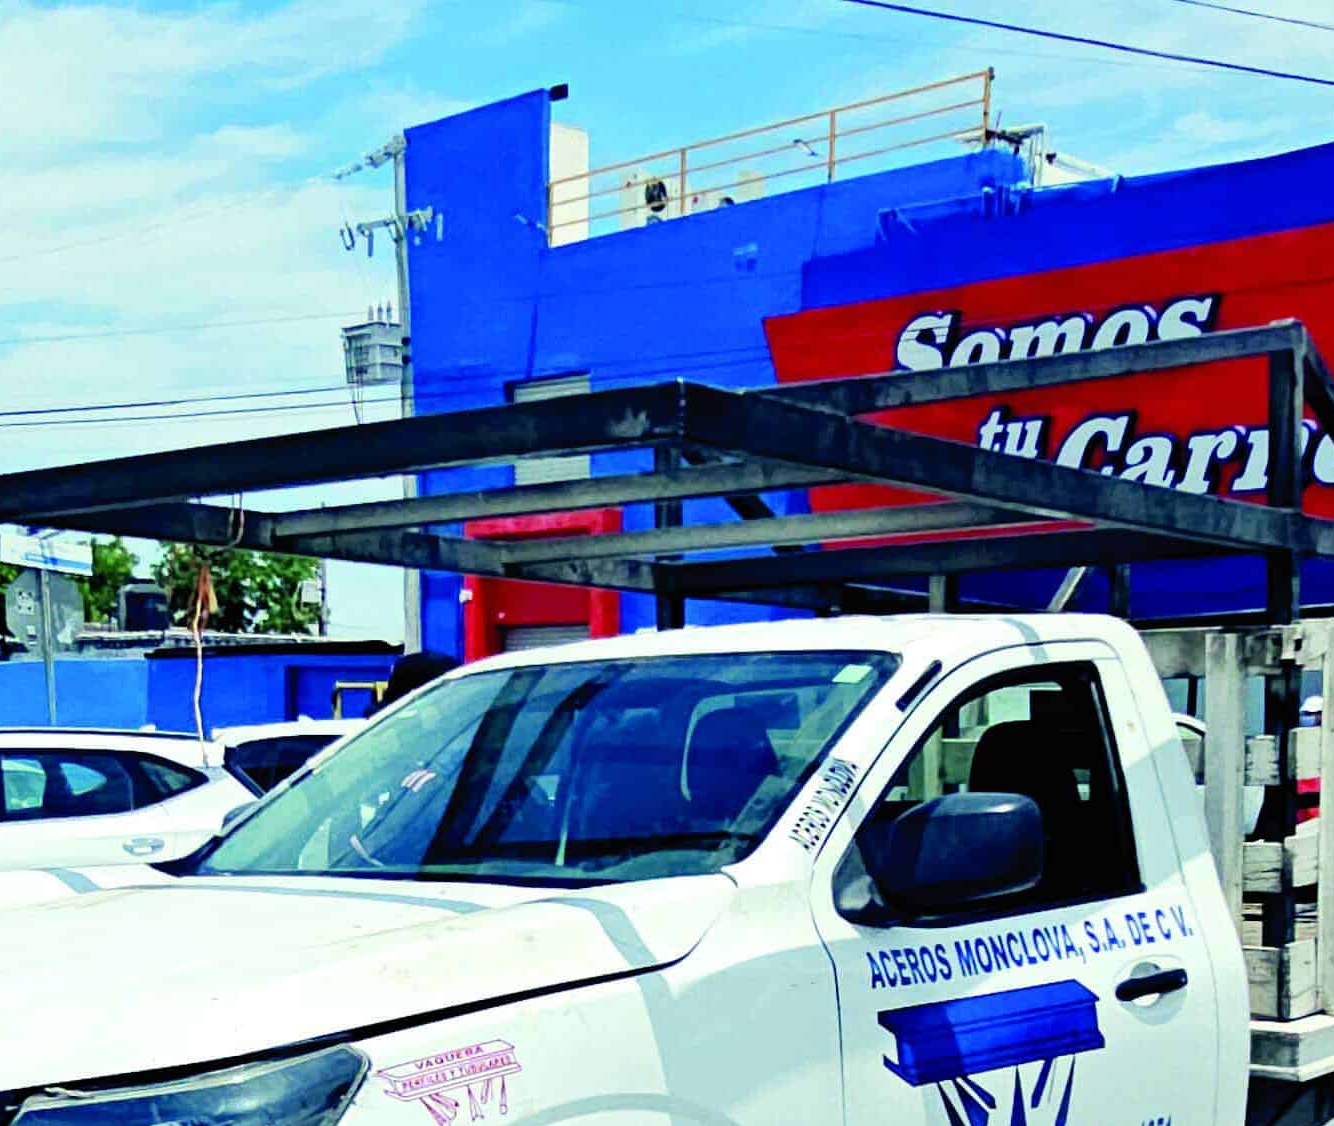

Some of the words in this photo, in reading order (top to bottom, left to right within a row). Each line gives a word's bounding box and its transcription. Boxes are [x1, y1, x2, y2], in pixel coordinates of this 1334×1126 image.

[896, 297, 1213, 372] Somos
[979, 410, 1044, 459] tu
[867, 943, 952, 989] ACEROS
[955, 924, 1086, 977] MONCLOVA,
[1084, 918, 1126, 953] S.A.
[1125, 911, 1155, 945] DE
